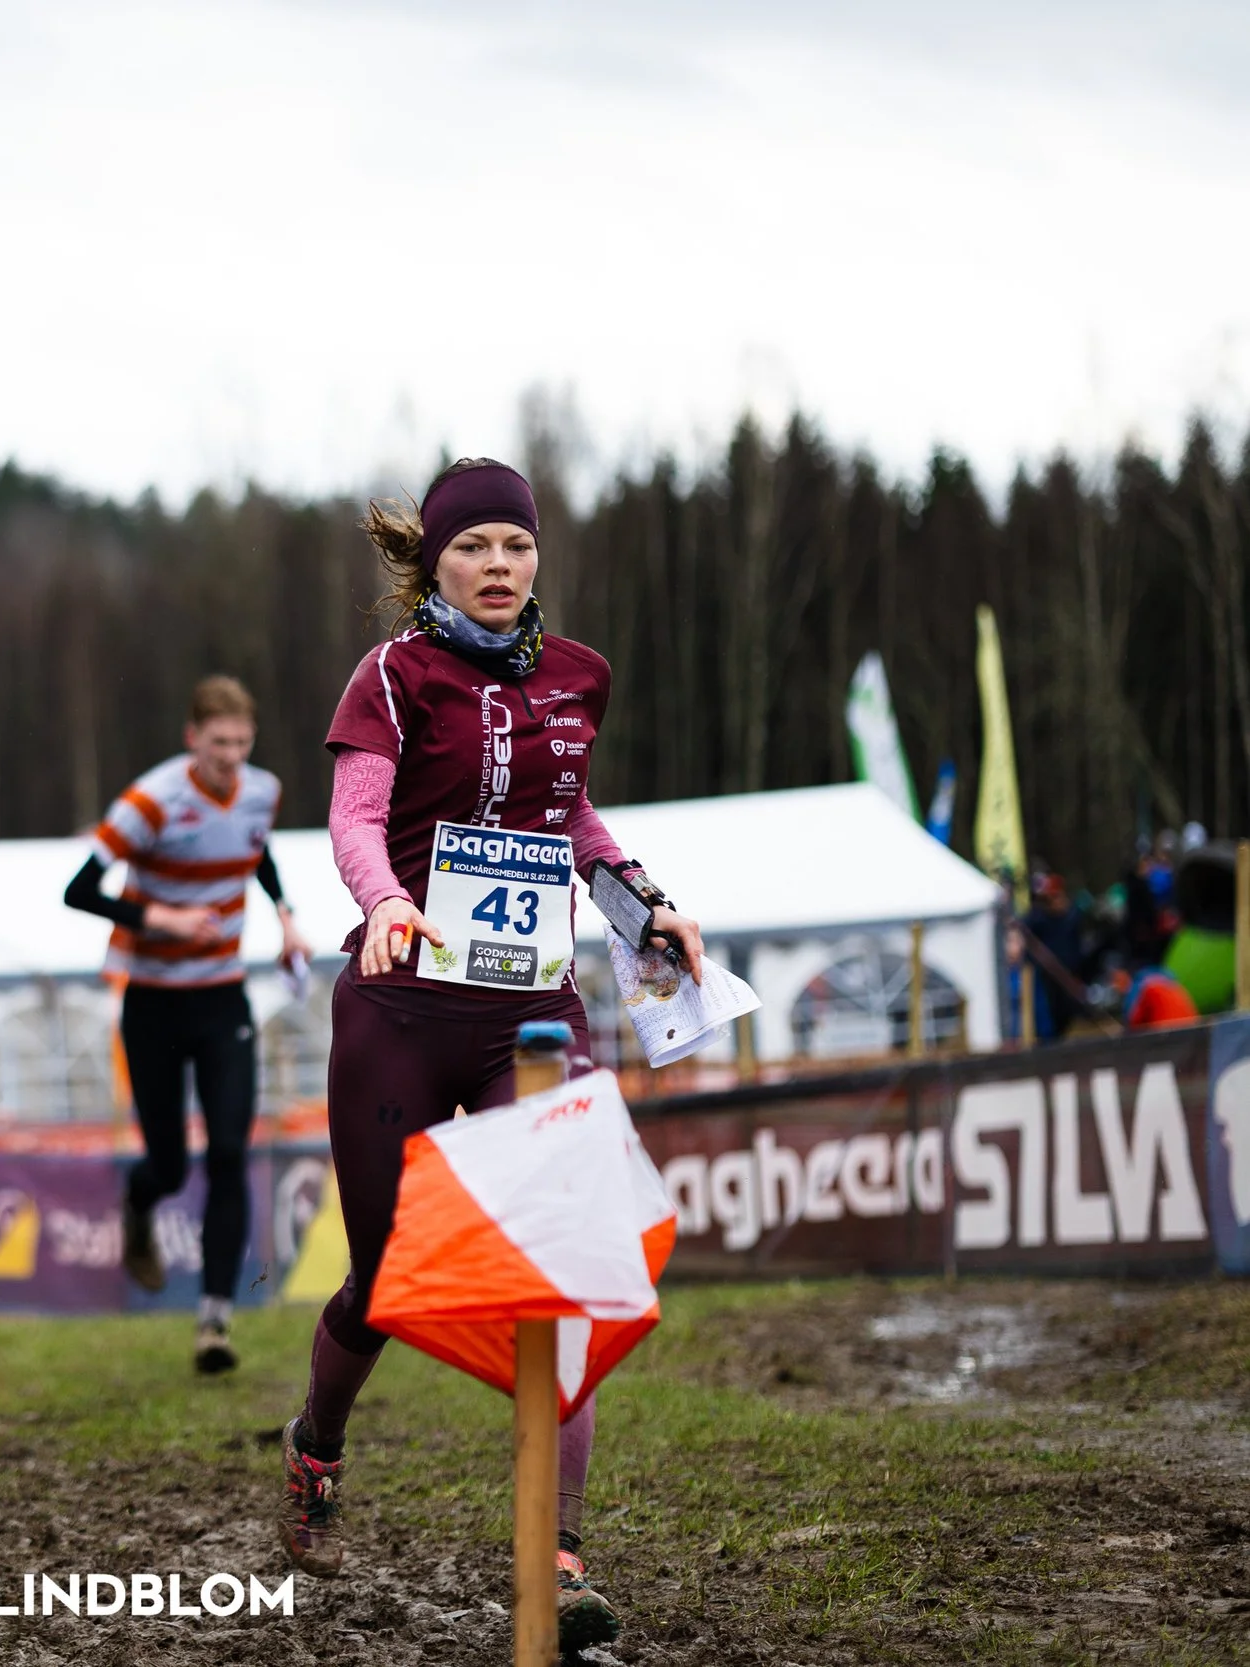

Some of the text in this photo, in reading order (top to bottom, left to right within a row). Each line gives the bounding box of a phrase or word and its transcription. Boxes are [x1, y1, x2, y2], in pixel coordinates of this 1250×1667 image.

[561, 771, 576, 783] ICA
[439, 828, 571, 866] bagheera
[453, 862, 530, 880] KOLMÅRDSMEDELN
[471, 886, 540, 936] 43
[476, 946, 533, 961] GODKÄNDA
[473, 956, 531, 973] AVLOPP
[485, 972, 515, 980] SVERIGE
[953, 1060, 1209, 1250] SILVA
[661, 1126, 945, 1250] agheera
